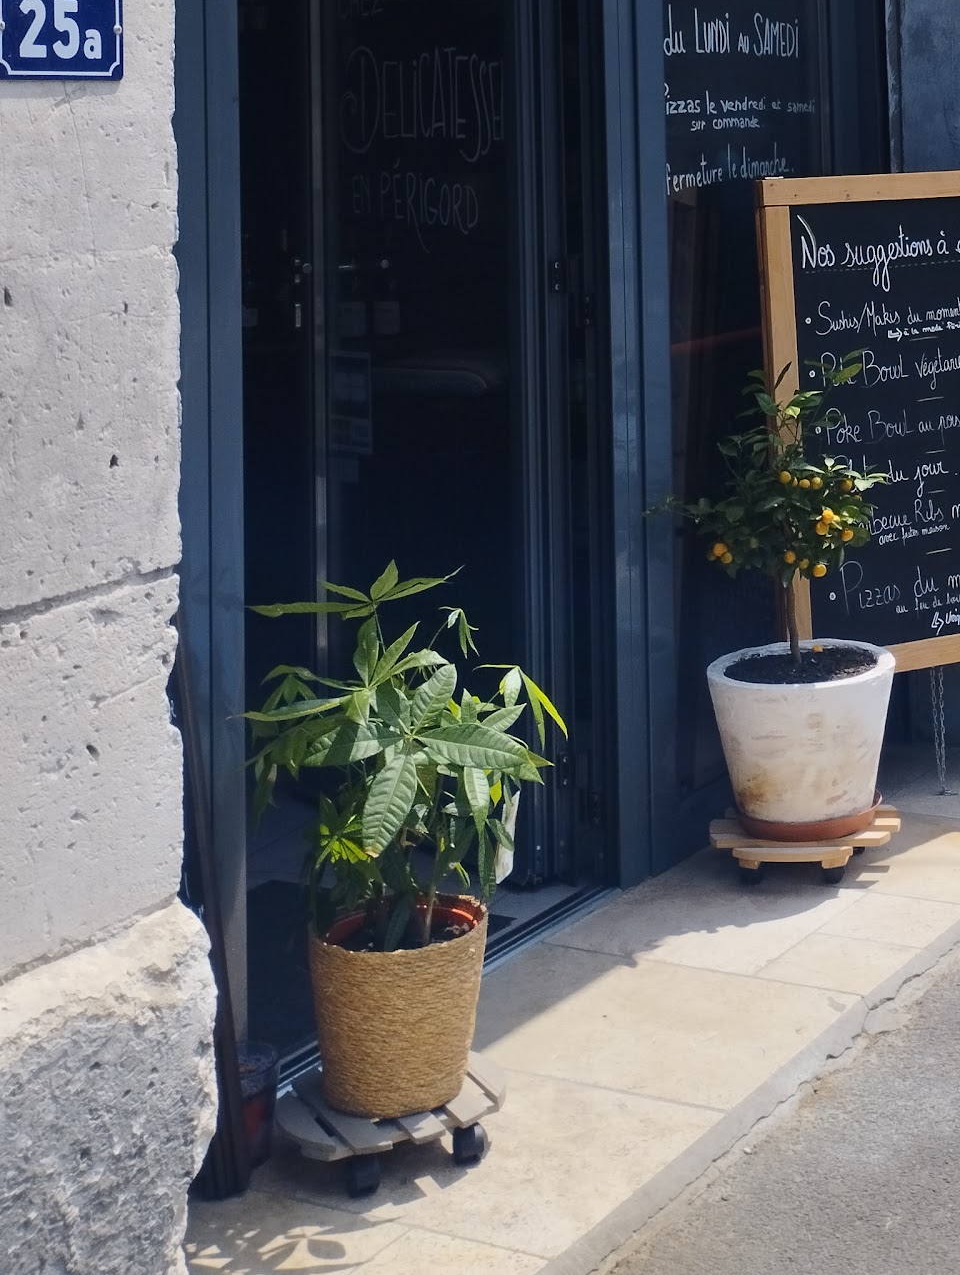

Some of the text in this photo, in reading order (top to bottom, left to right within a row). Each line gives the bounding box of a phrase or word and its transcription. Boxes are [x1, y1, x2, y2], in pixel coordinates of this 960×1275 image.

[663, 3, 687, 57] du
[706, 90, 718, 116] le
[720, 96, 766, 114] vendredi
[787, 99, 815, 115] samedi
[690, 119, 706, 132] sur
[727, 142, 738, 180] le
[797, 214, 836, 270] Nos
[840, 224, 933, 293] suggestions
[936, 229, 950, 255] à
[906, 306, 924, 326] du
[918, 419, 936, 433] au
[886, 459, 910, 486] du
[912, 461, 950, 499] jour
[878, 532, 900, 546] avec
[839, 560, 901, 616] Pizzas
[913, 565, 940, 598] du
